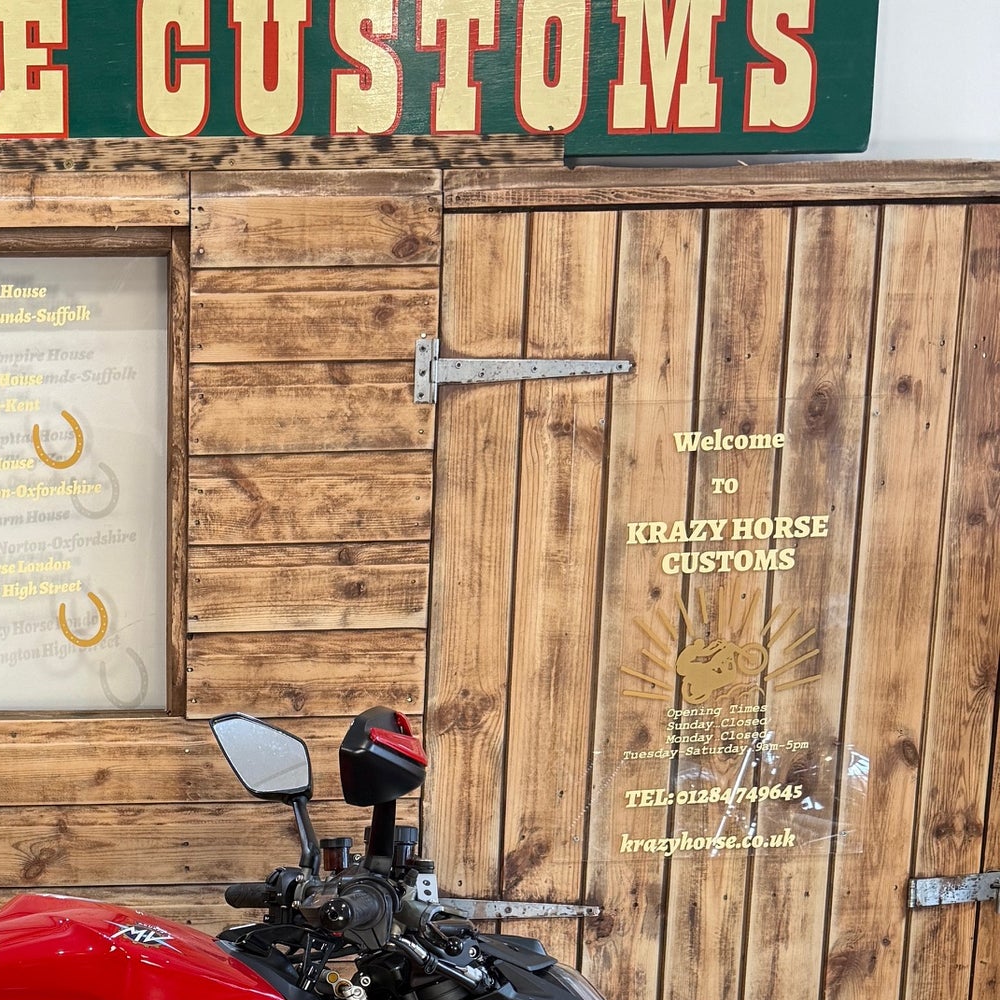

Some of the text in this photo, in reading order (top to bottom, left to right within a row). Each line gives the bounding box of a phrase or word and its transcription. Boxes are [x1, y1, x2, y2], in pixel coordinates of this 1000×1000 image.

[137, 0, 817, 137] CUSTOMS
[0, 284, 46, 300] House
[673, 428, 785, 452] Welcome
[712, 478, 738, 494] TO
[626, 515, 829, 545] KRAZY HORSE
[18, 558, 72, 575] London
[662, 548, 796, 574] CUSTOMS
[2, 583, 38, 600] High
[40, 580, 82, 595] Street
[667, 704, 768, 718] Opening Times
[620, 828, 796, 856] krazyhorse.co.uk
